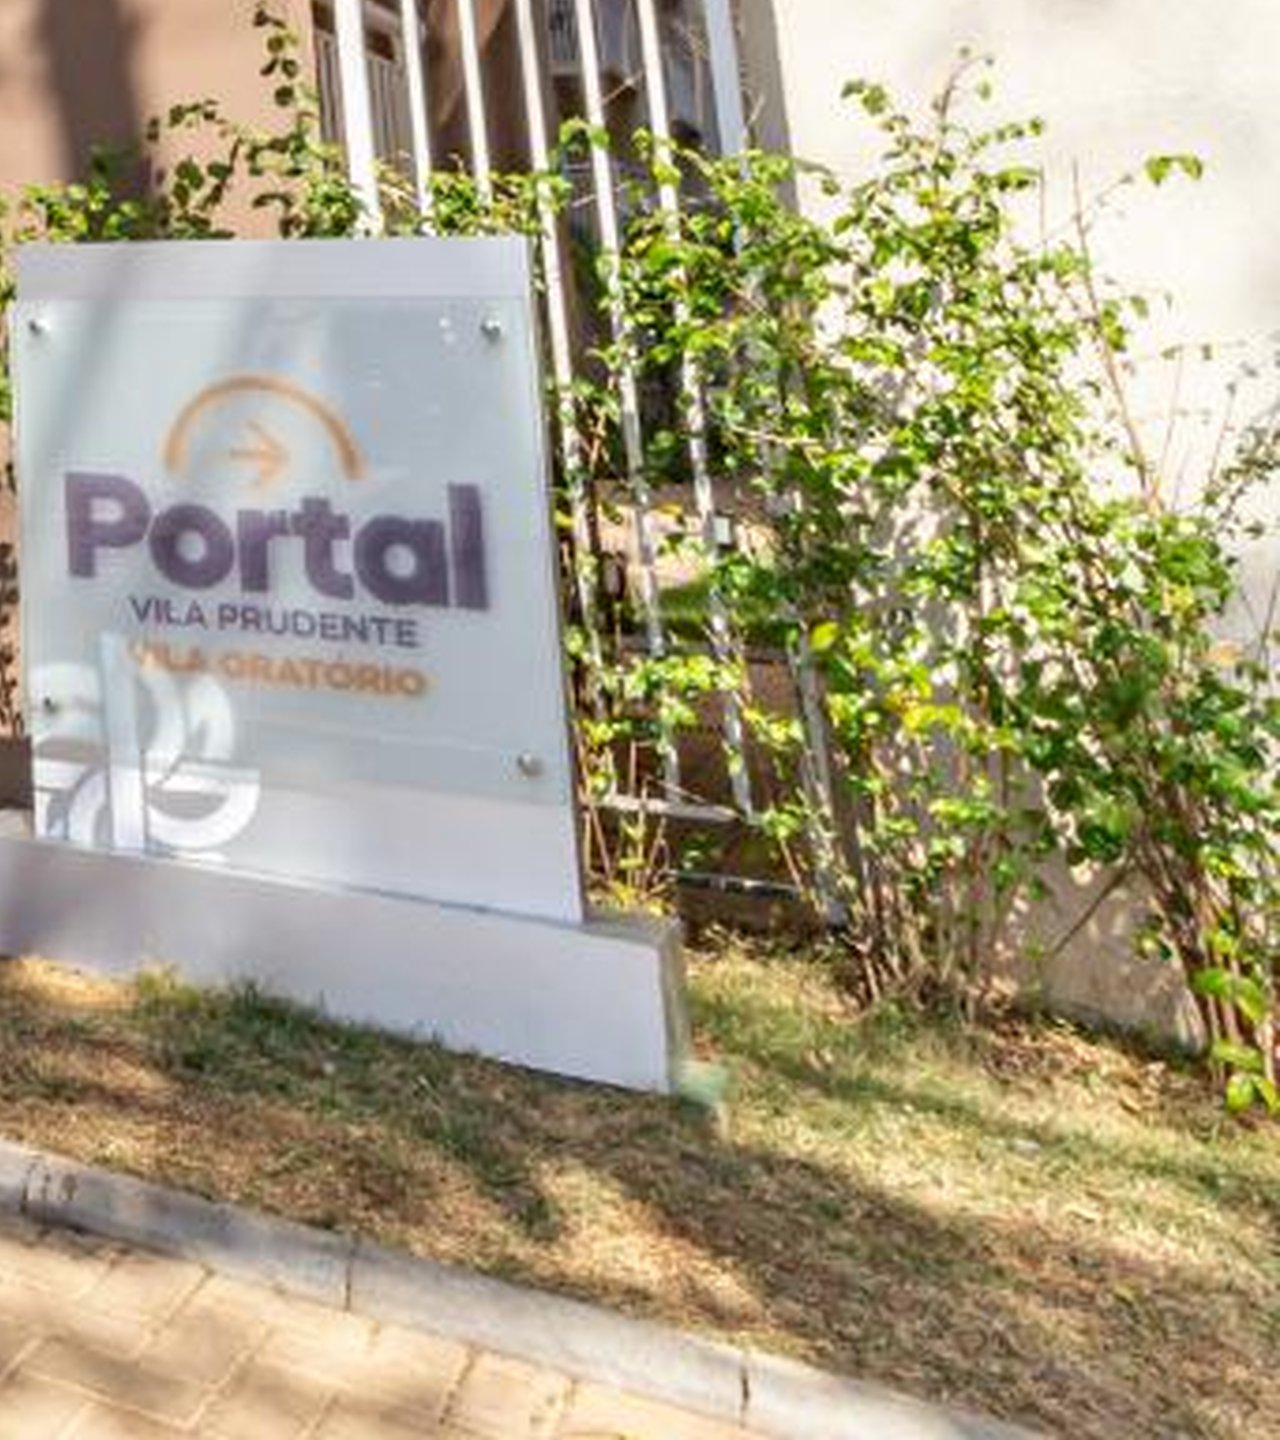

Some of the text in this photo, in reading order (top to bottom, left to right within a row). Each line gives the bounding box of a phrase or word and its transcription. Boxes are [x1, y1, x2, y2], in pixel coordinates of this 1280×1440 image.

[65, 471, 489, 611] Portal
[128, 597, 420, 648] VILA PRUDENTE
[222, 651, 427, 698] ORATÓRIO
